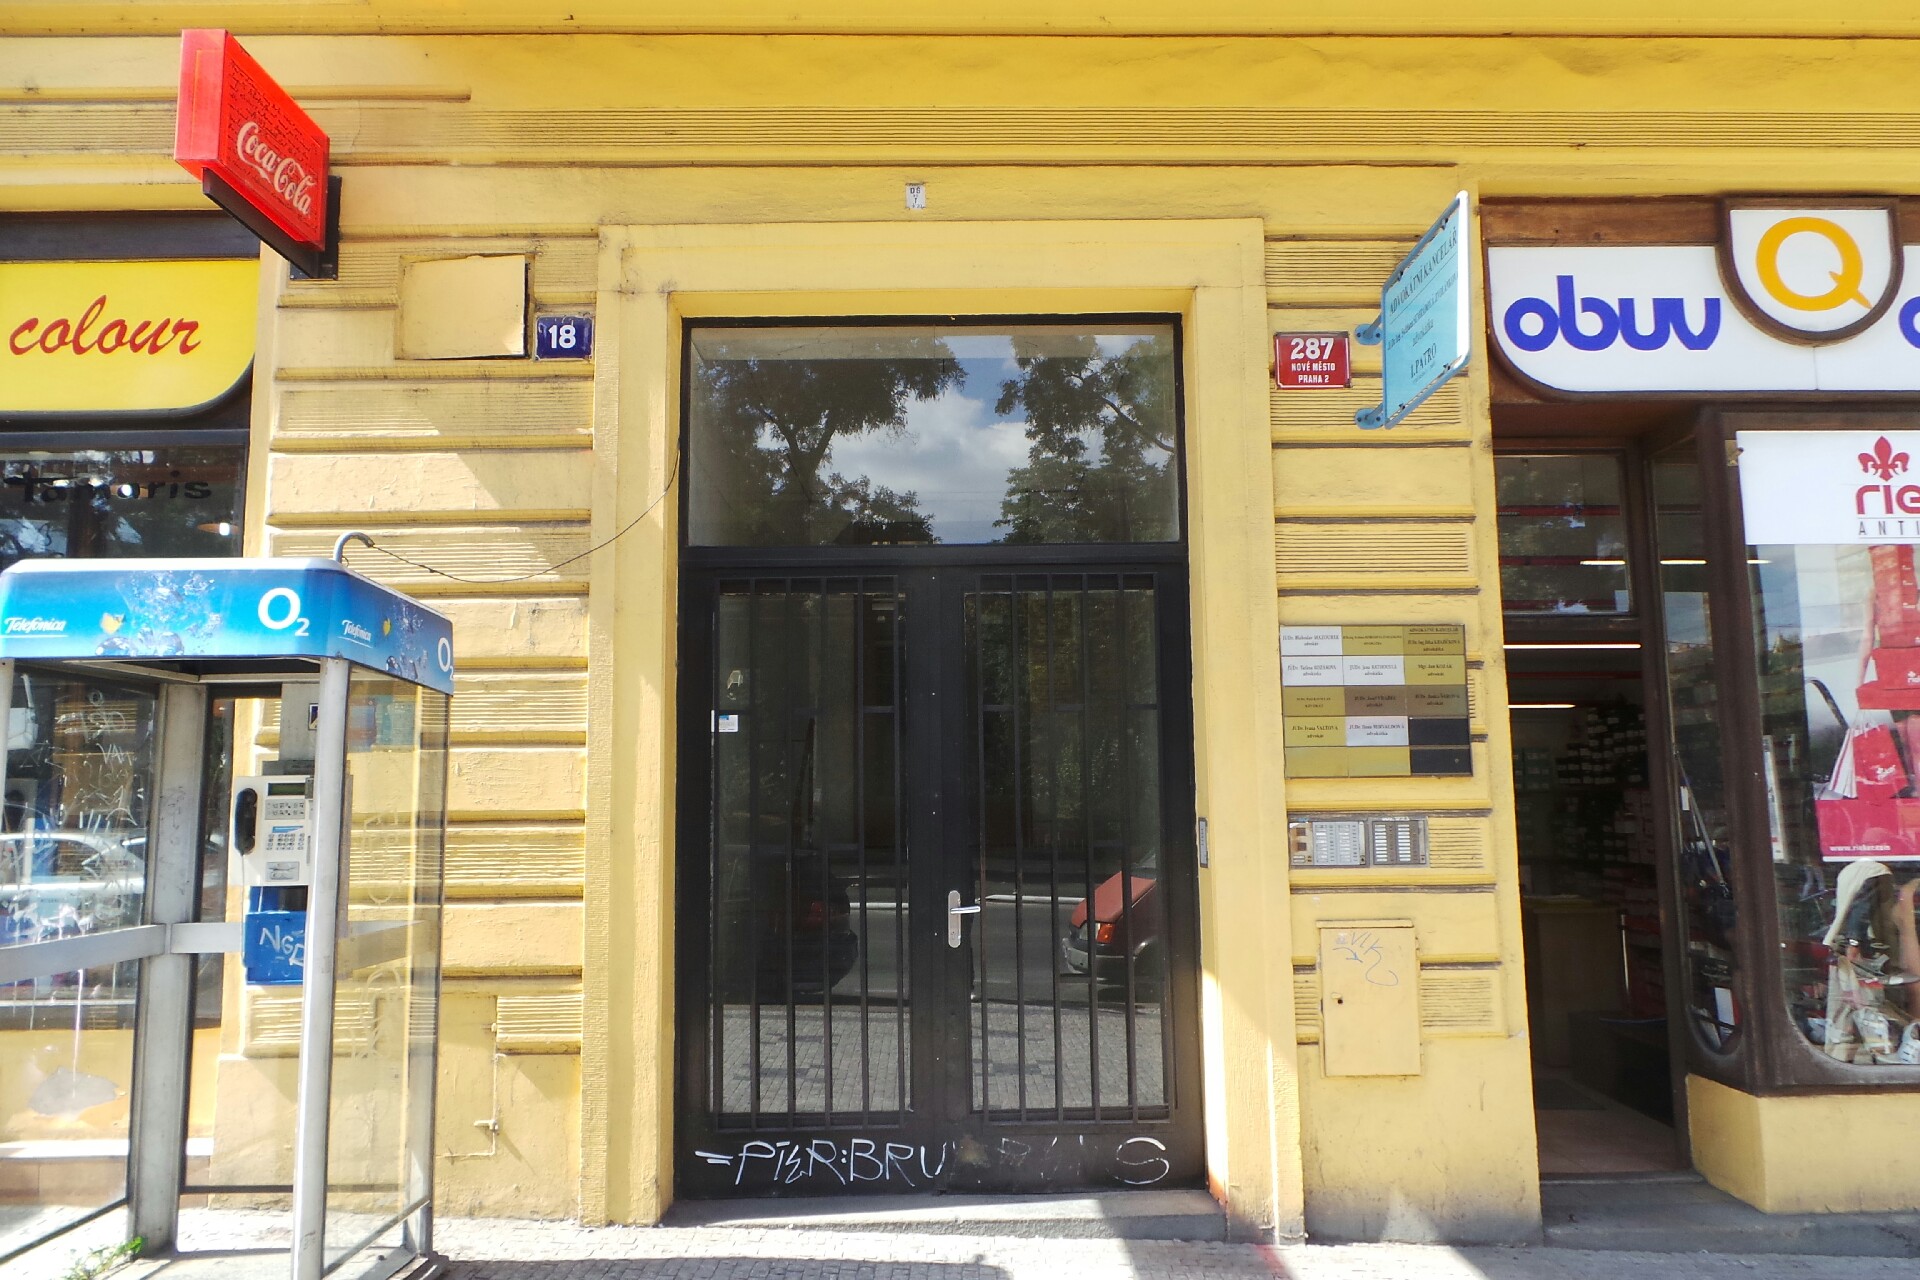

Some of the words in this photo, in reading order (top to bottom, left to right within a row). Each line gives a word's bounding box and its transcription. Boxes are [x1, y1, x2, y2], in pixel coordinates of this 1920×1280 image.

[237, 121, 316, 215] Coca-Cola
[1756, 216, 1873, 311] Q
[9, 294, 201, 355] colour
[1504, 275, 1720, 351] obuv
[548, 324, 576, 349] 18
[1290, 337, 1335, 360] 287
[1291, 361, 1311, 372] NOVÉ
[1312, 361, 1336, 371] MĚSTO
[1298, 374, 1323, 383] PRAHA
[1324, 374, 1330, 383] 2
